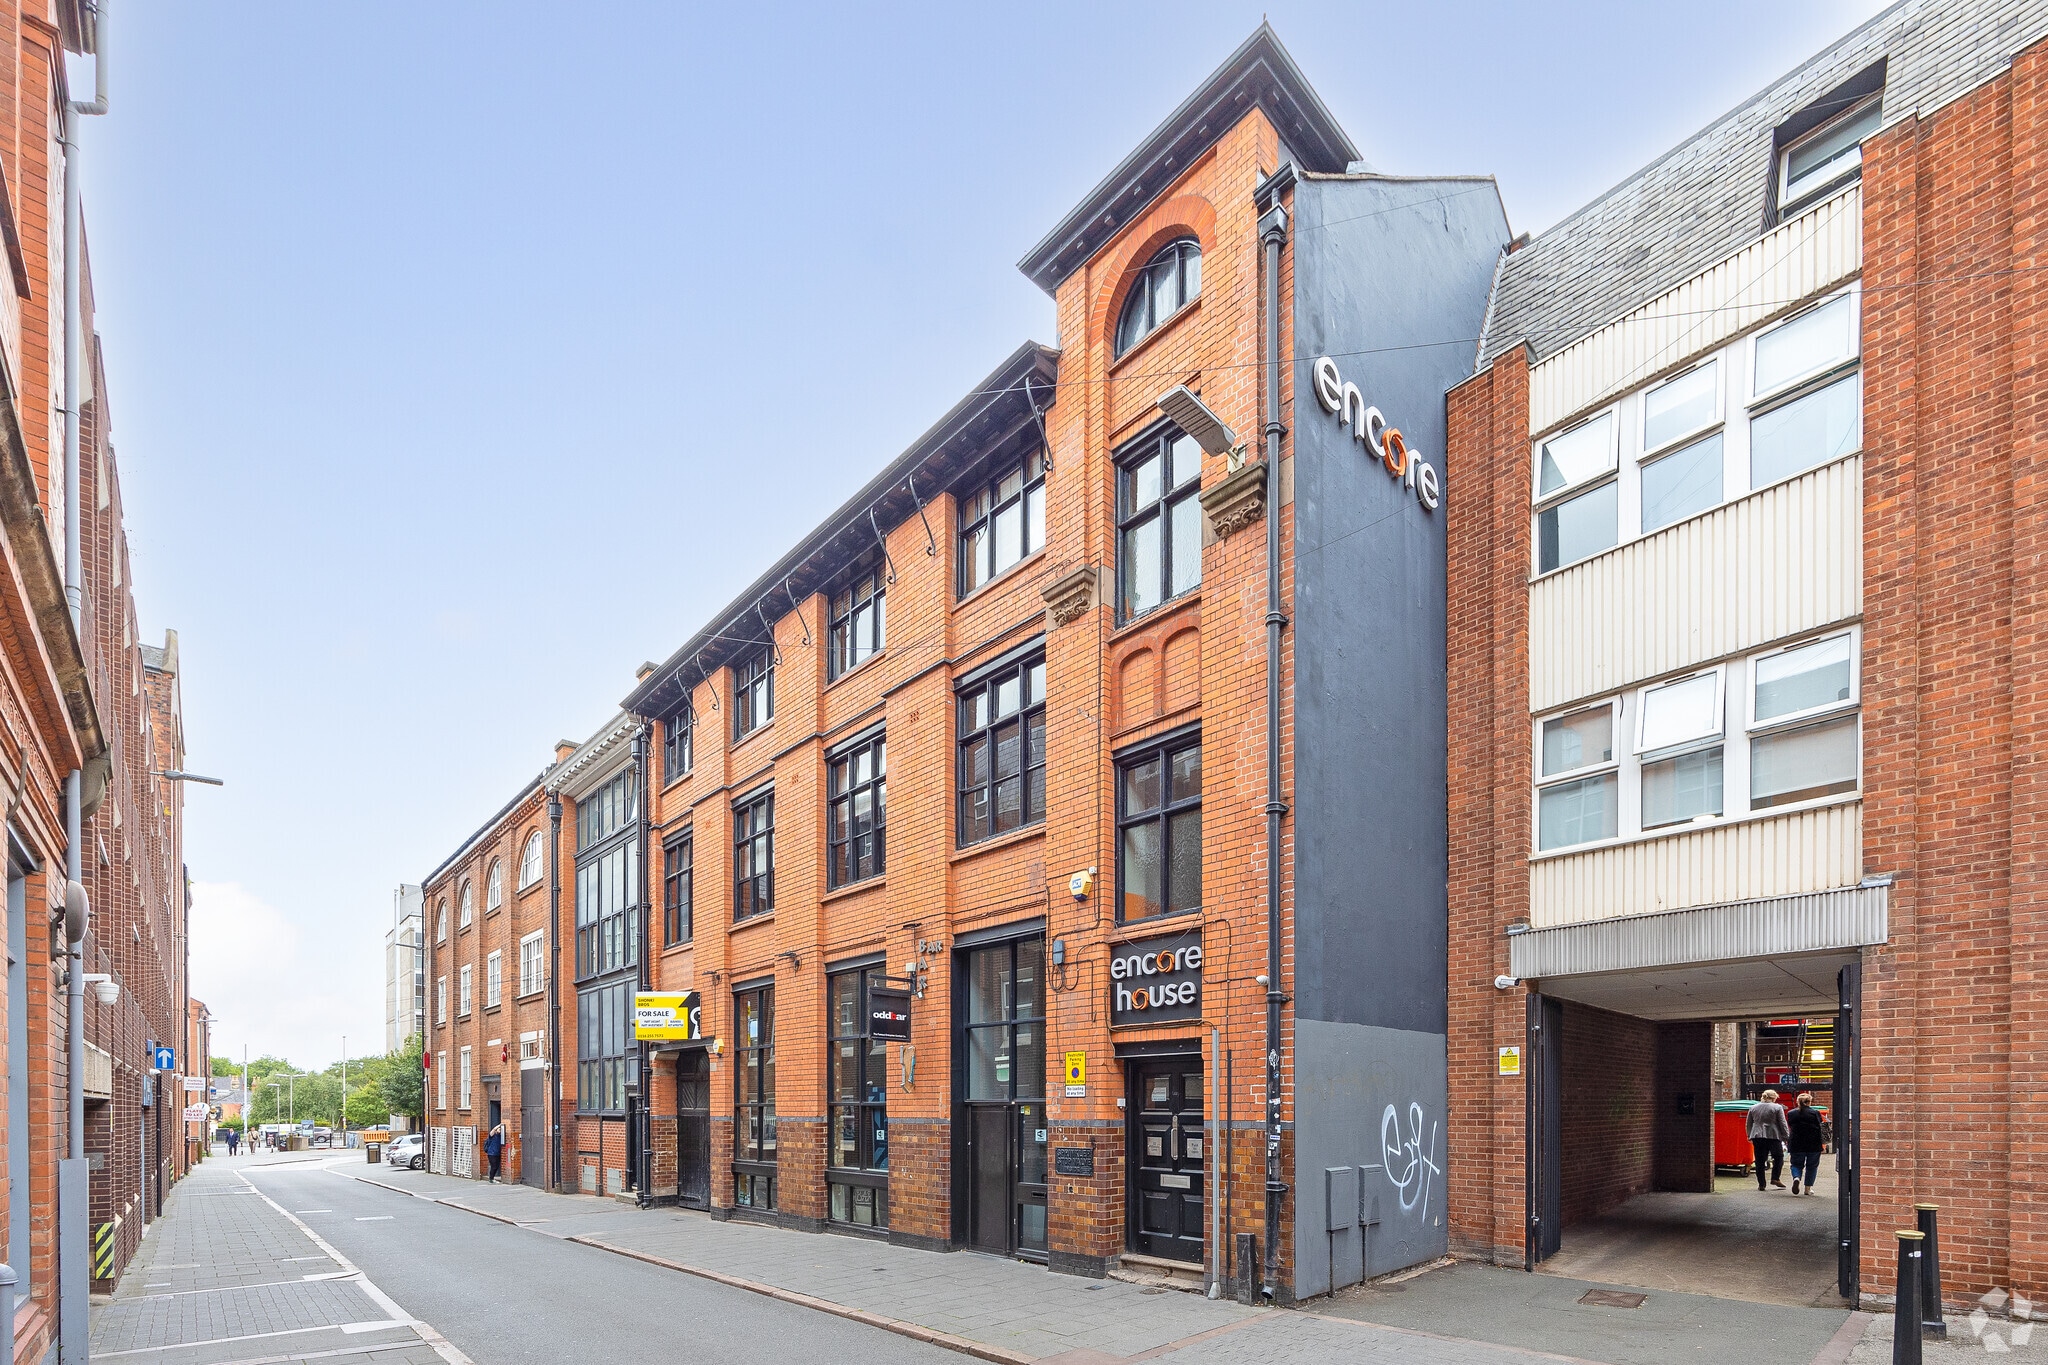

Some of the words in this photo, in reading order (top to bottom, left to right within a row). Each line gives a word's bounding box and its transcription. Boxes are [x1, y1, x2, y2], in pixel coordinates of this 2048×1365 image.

[1313, 356, 1439, 511] encore
[918, 939, 943, 954] BAR
[1110, 945, 1202, 979] encore
[1116, 981, 1197, 1011] house
[872, 1010, 907, 1021] oddbar
